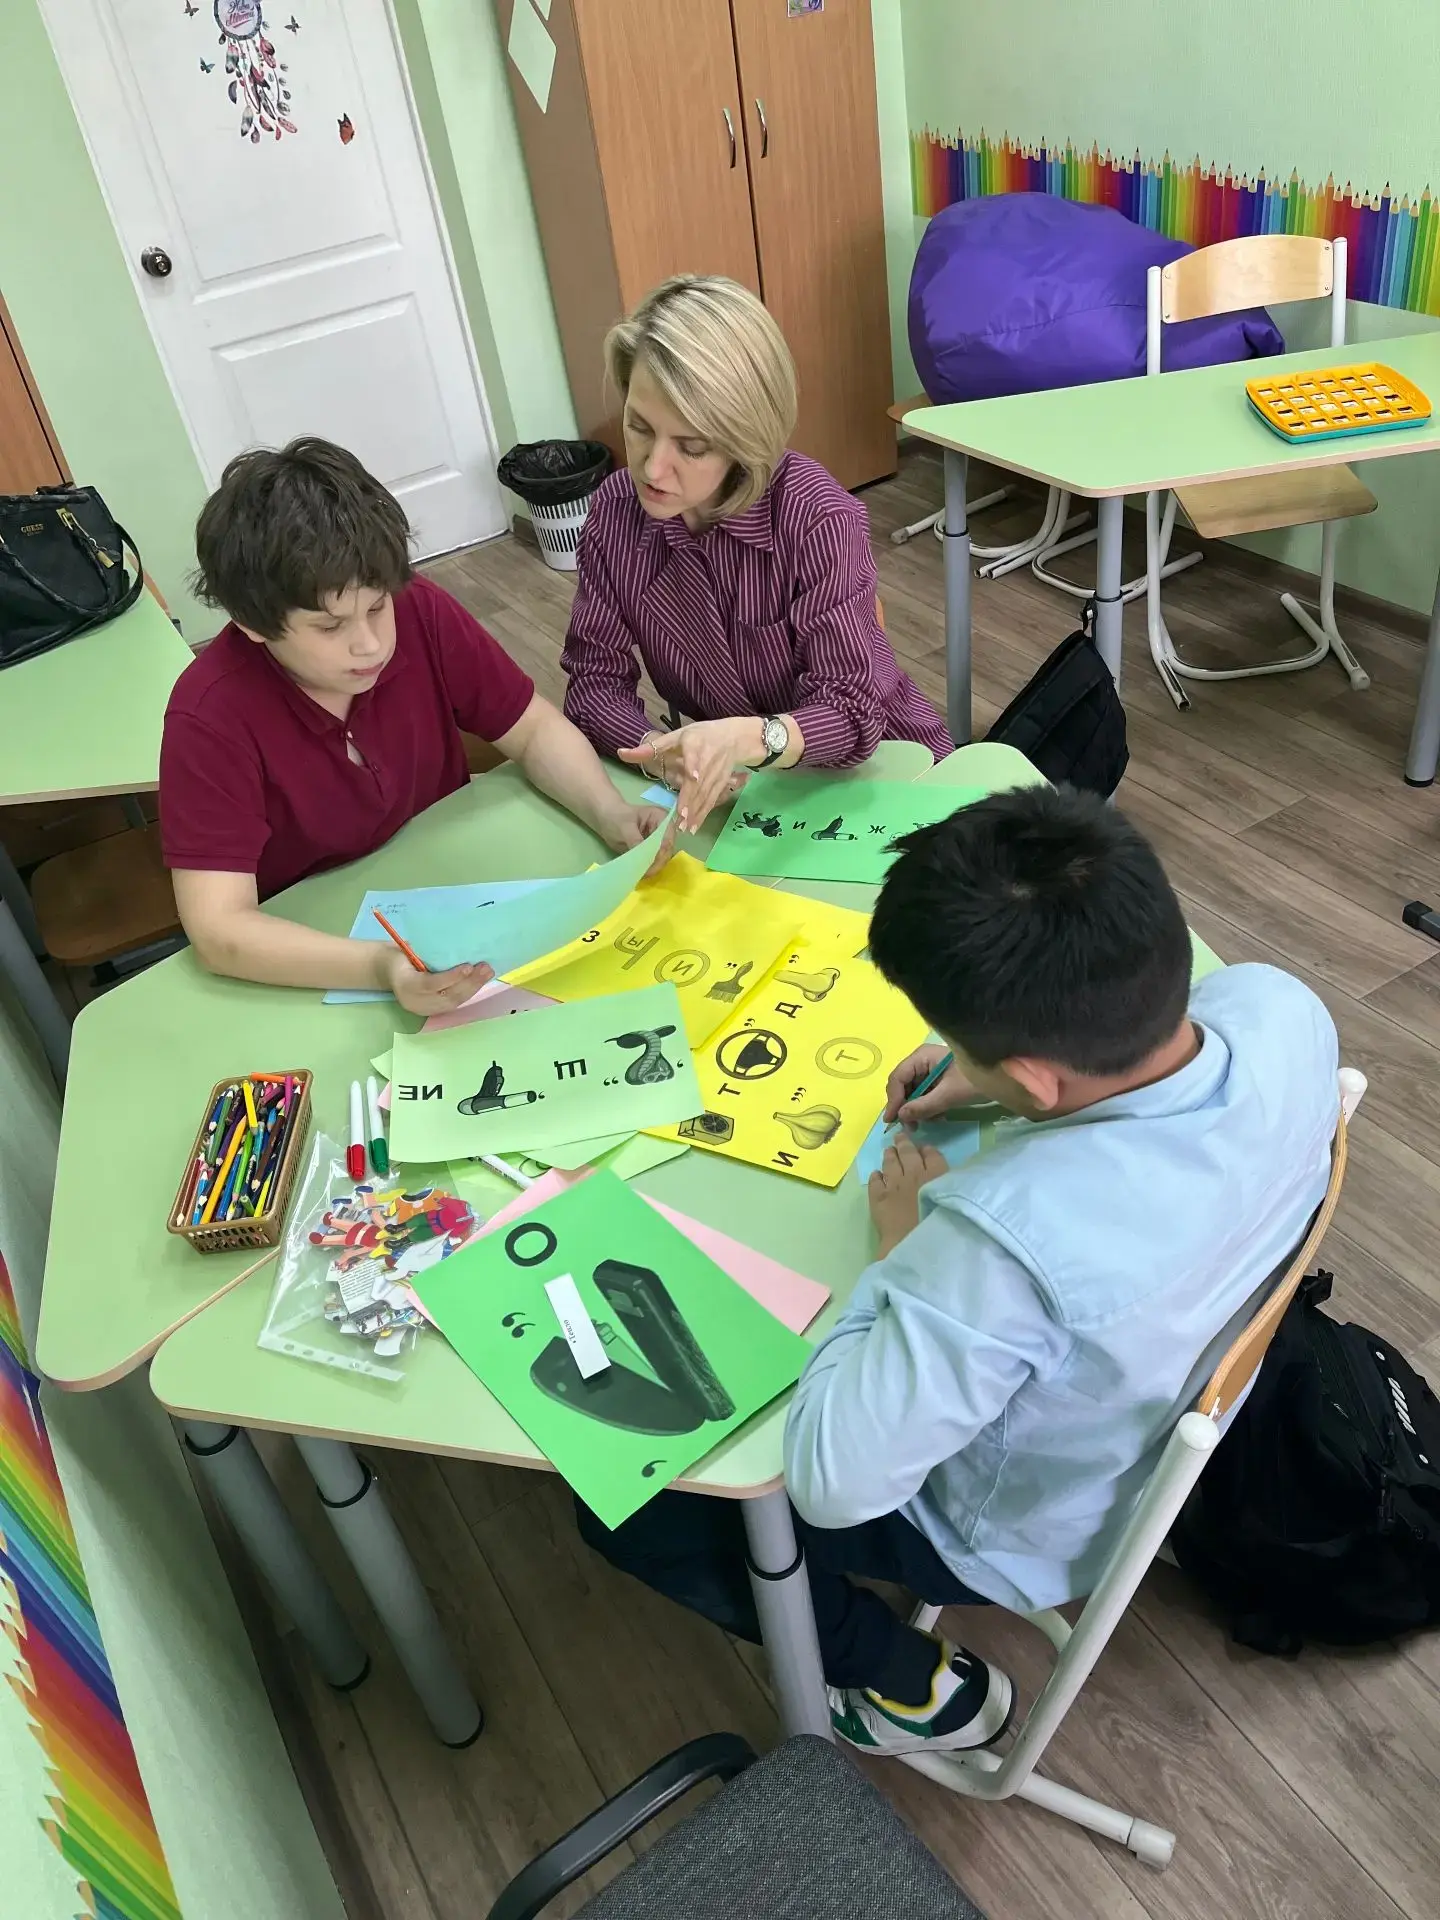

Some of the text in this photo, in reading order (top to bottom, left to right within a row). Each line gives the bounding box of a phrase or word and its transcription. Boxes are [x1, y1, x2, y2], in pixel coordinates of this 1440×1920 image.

[21, 523, 44, 533] GUESS
[792, 821, 887, 834] Ж И
[717, 1001, 803, 1096] Т Д
[553, 1058, 587, 1081] Щ
[771, 1150, 800, 1168] И
